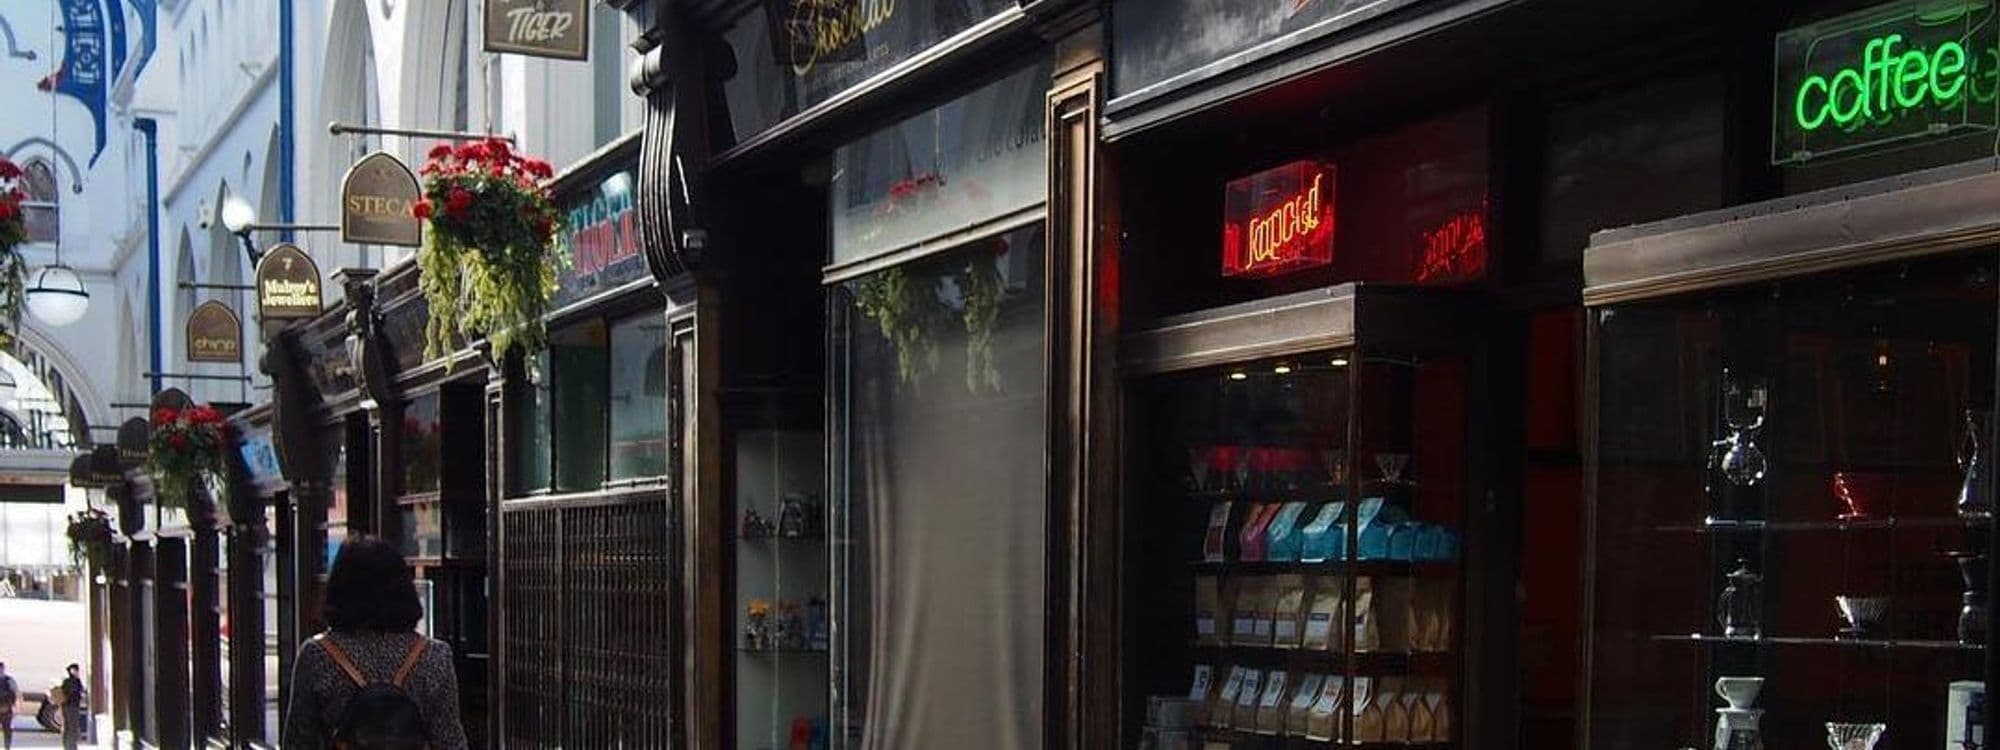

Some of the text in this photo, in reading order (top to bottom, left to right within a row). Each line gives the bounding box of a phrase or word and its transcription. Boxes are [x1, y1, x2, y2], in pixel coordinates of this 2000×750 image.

[507, 7, 573, 42] TIGER
[1796, 34, 1967, 131] coffee
[262, 293, 320, 306] Jewellers
